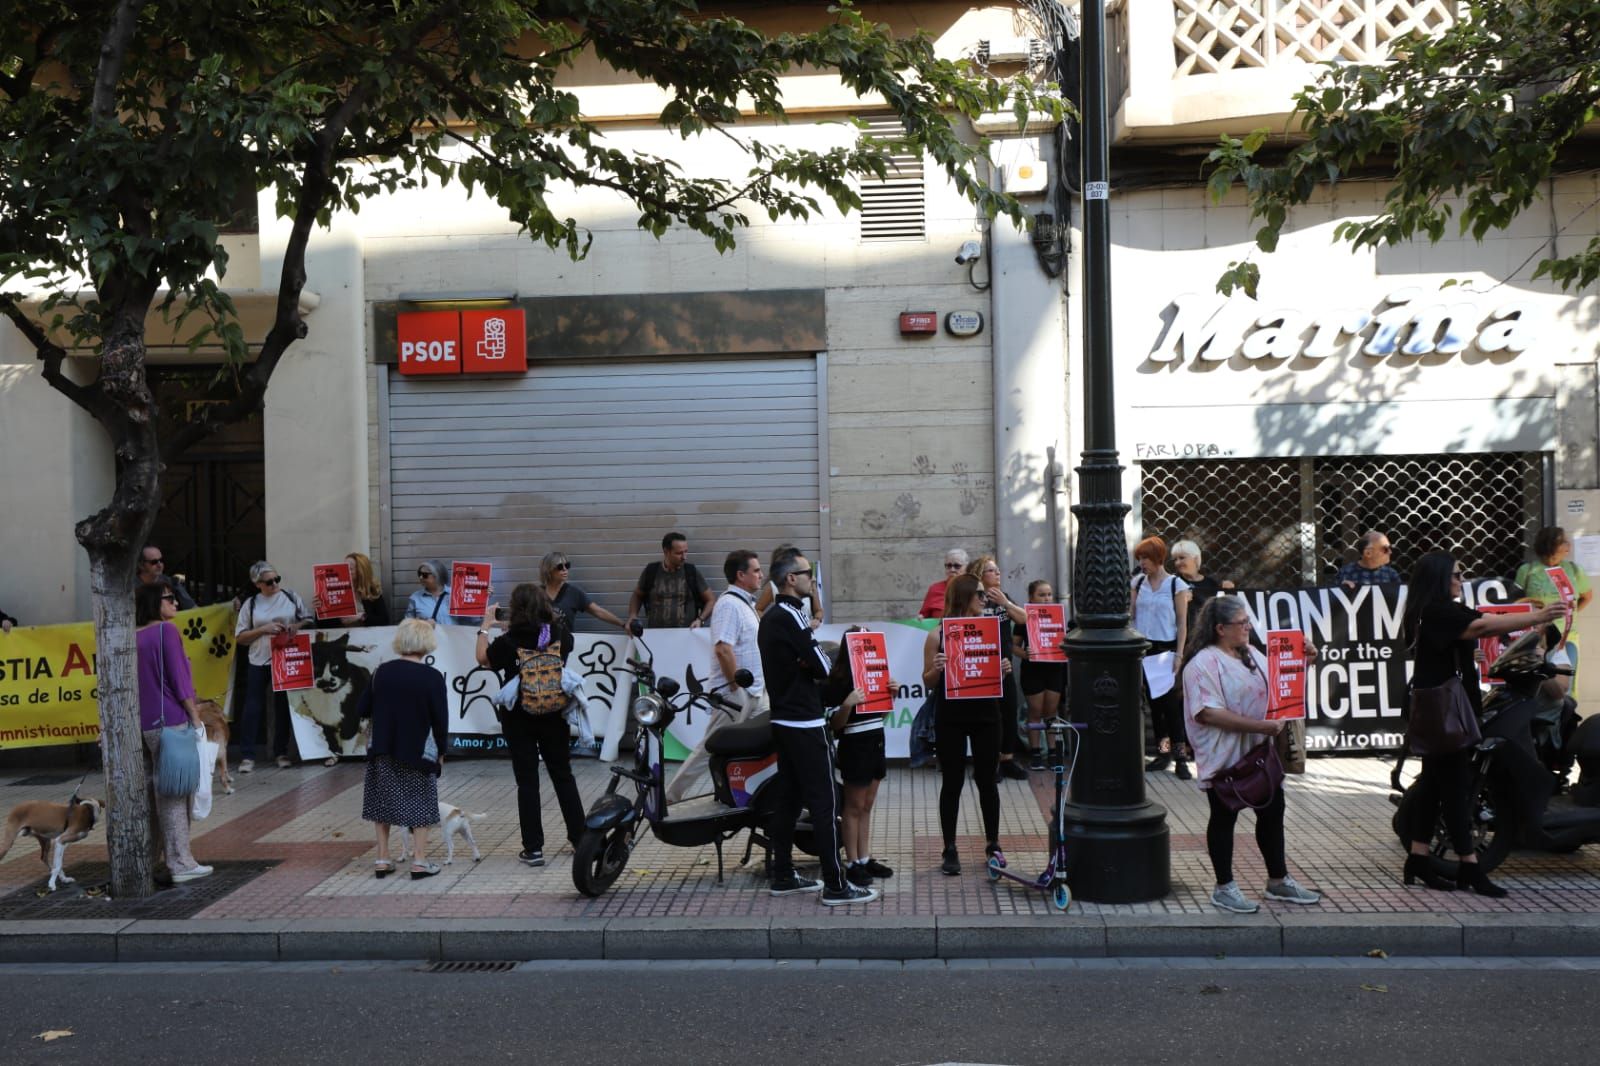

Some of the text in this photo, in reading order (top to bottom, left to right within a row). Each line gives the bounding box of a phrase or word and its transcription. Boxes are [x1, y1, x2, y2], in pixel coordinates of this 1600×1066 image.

[1147, 286, 1535, 364] Marina
[402, 341, 456, 362] PSOE
[1320, 643, 1392, 660] for the
[28, 688, 49, 704] de
[58, 686, 82, 702] los
[453, 737, 484, 748] Amor
[487, 740, 493, 749] y
